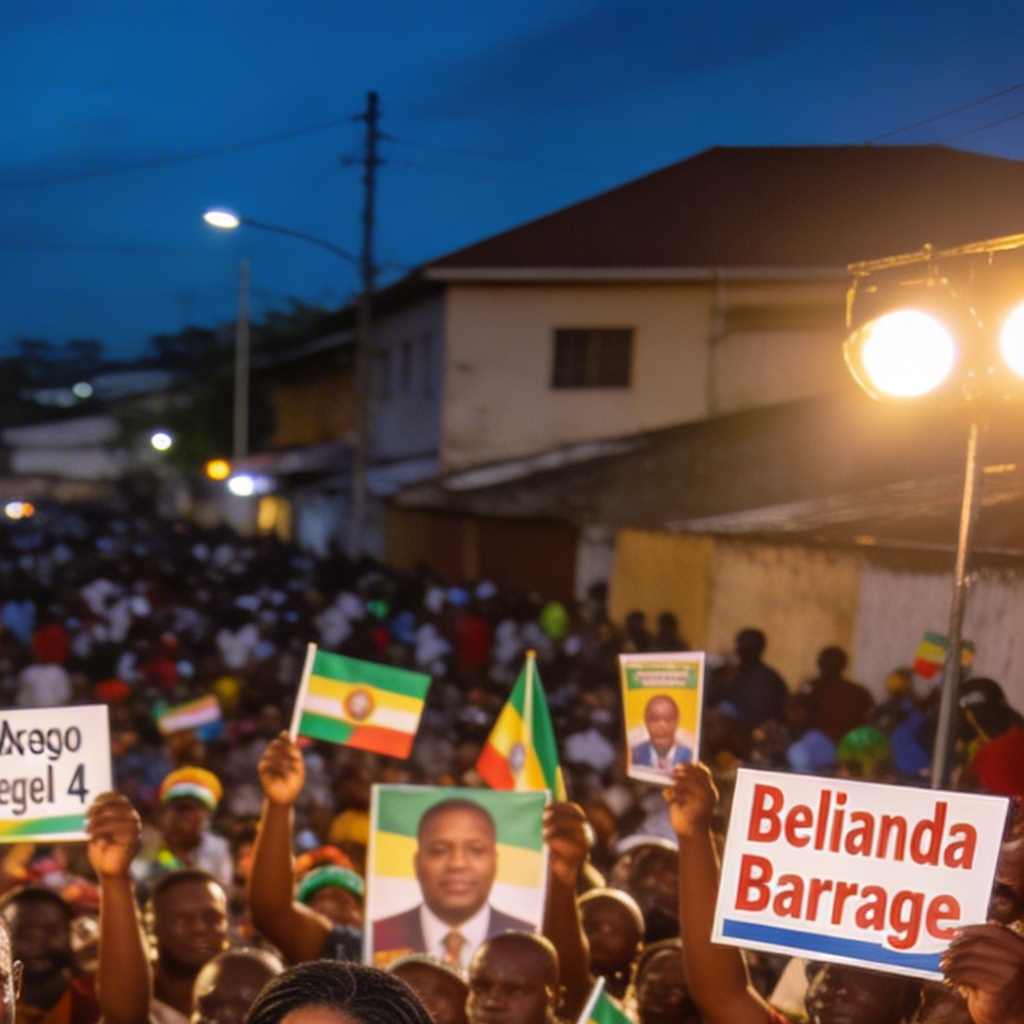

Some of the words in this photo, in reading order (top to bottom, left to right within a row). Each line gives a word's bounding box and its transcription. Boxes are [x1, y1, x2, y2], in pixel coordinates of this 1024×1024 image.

[67, 763, 89, 804] 4
[747, 783, 977, 870] Belianda
[734, 853, 962, 950] Barrage
